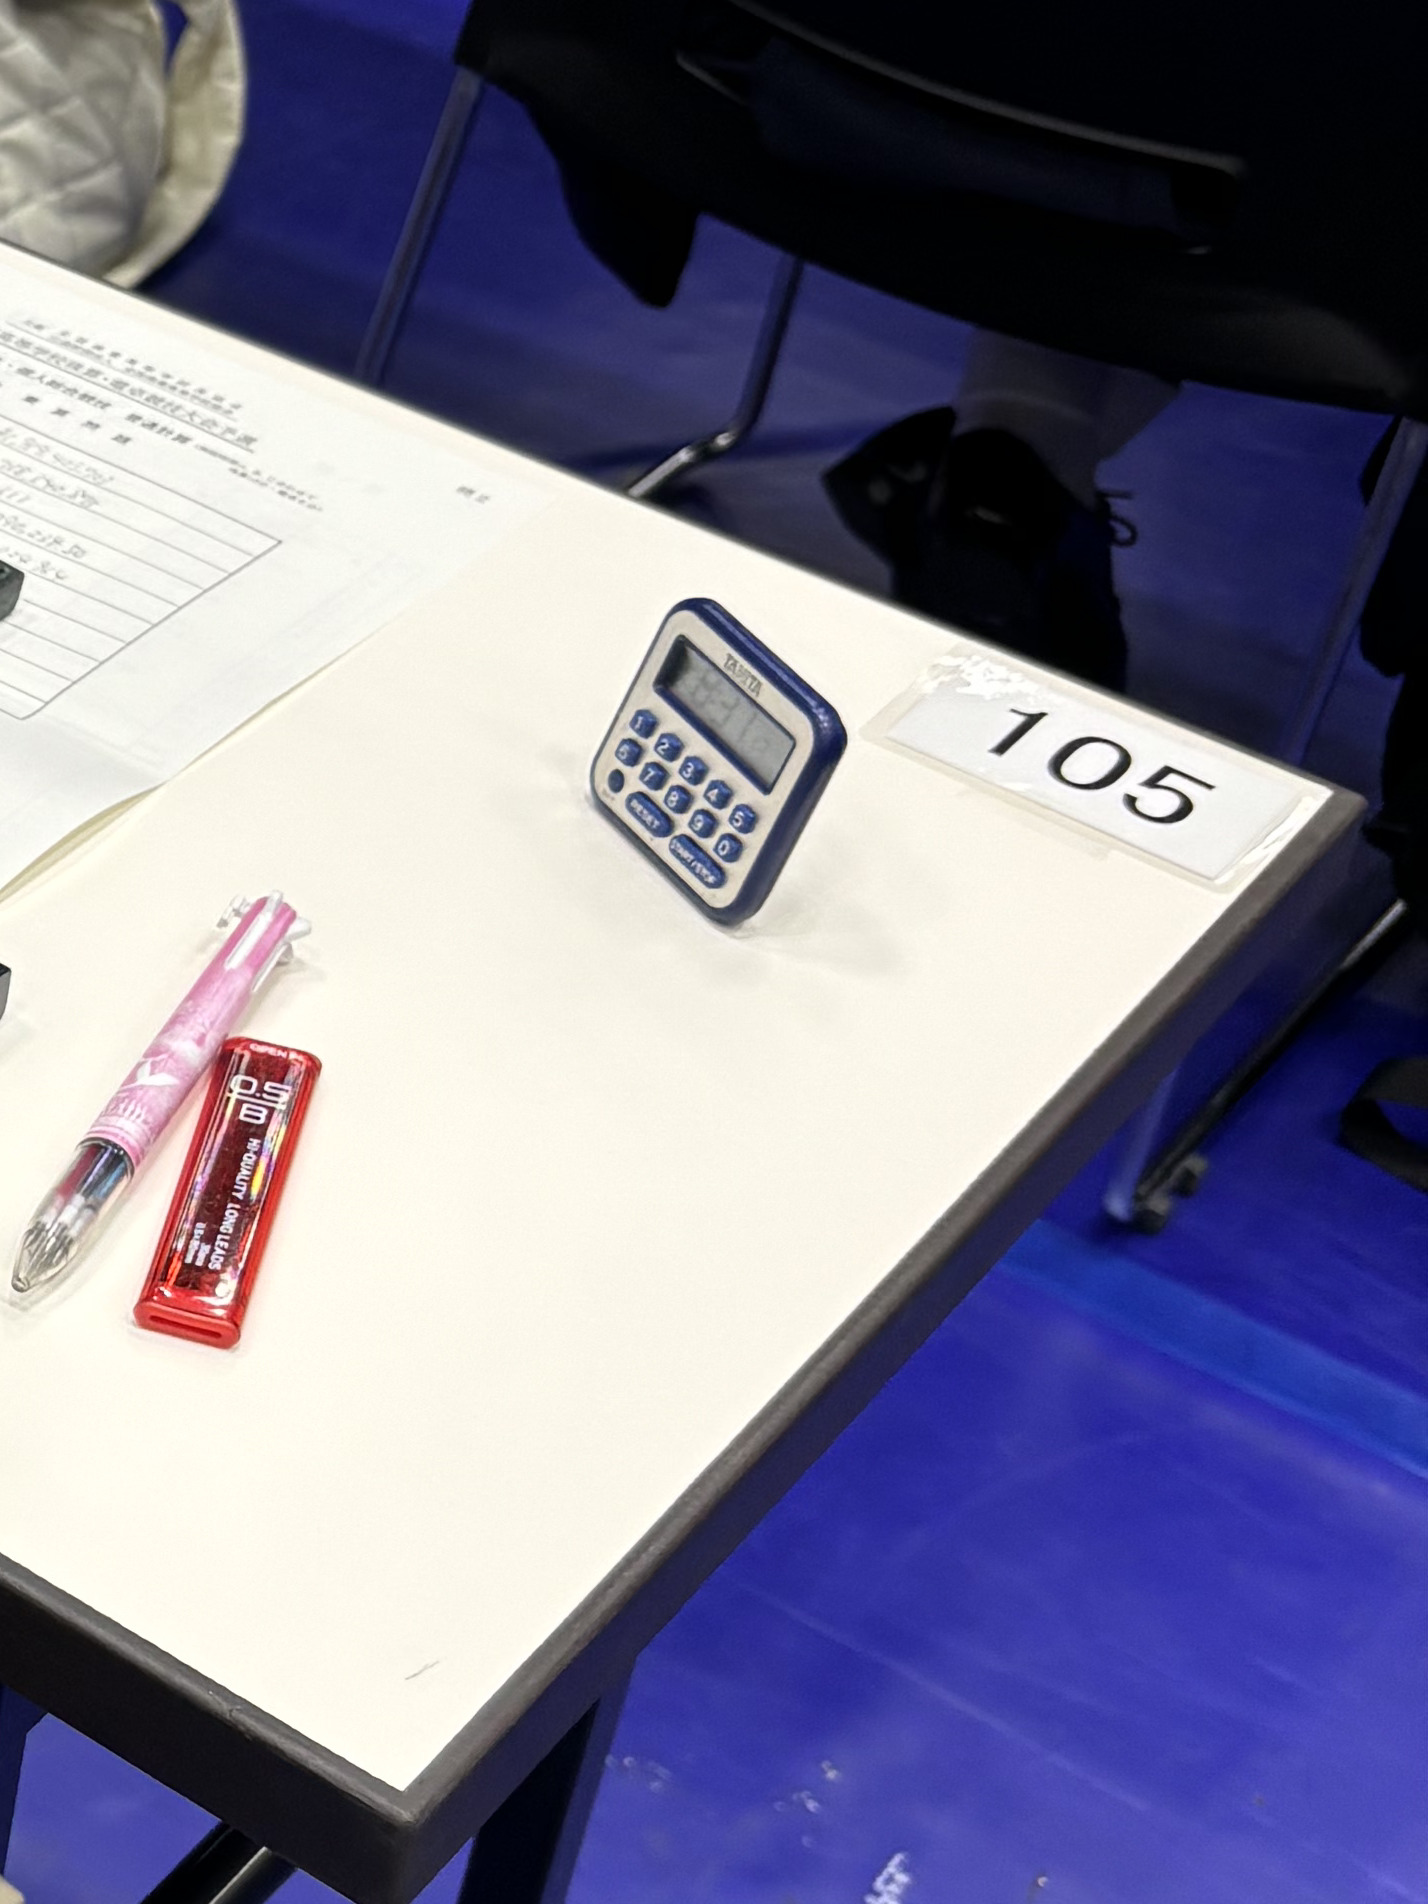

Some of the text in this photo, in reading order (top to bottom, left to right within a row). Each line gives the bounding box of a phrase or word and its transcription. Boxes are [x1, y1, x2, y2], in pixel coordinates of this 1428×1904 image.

[633, 715, 746, 828] 1 2 3 4 5
[643, 768, 656, 784] 7
[667, 790, 680, 808] 8
[691, 813, 704, 830] 9
[717, 839, 730, 856] 0
[988, 707, 1217, 825] 105
[229, 1073, 294, 1104] 0.5
[207, 1136, 263, 1271] HI-QUALITY LONG LEADS
